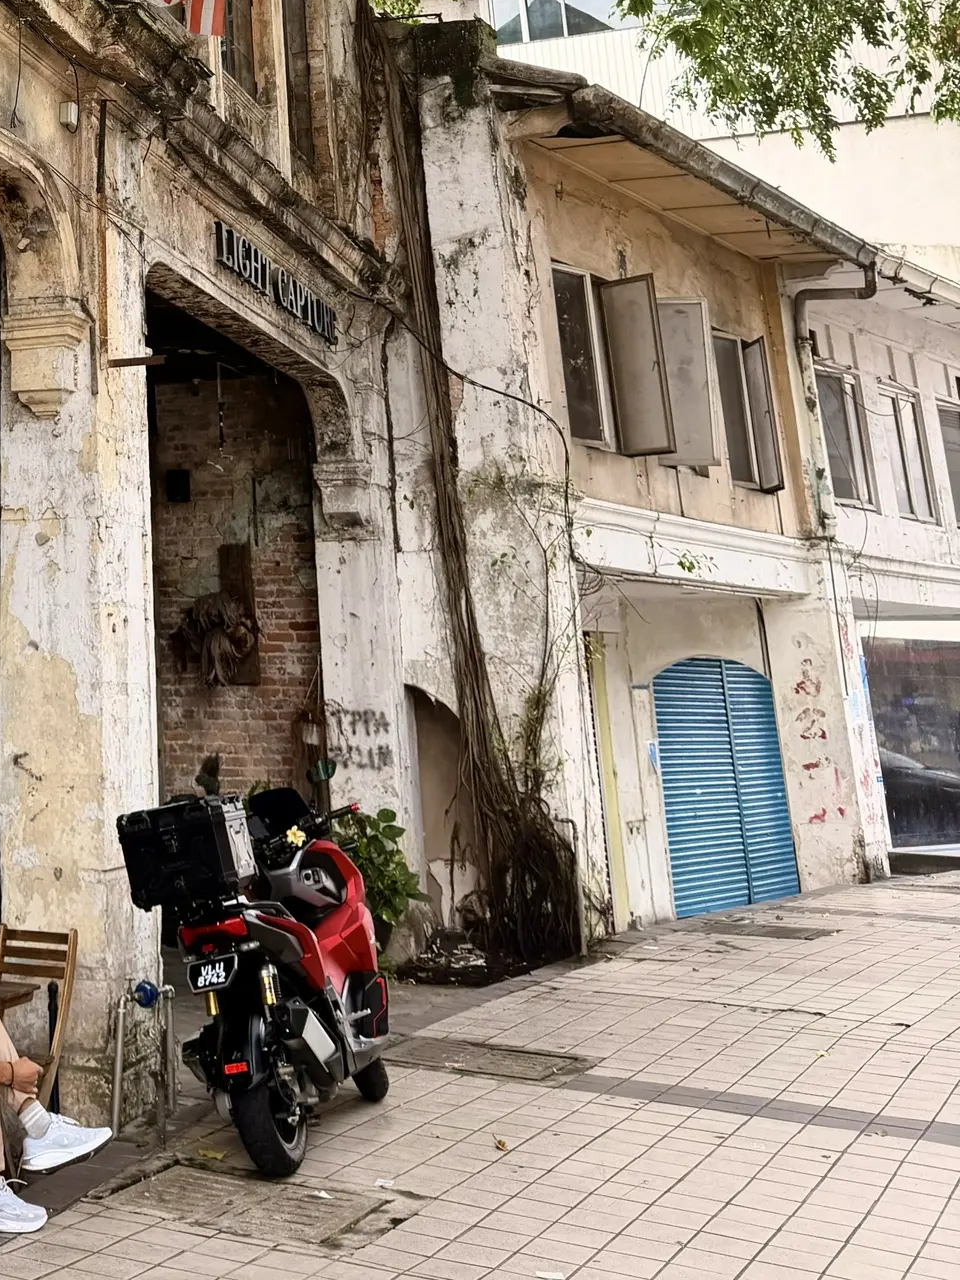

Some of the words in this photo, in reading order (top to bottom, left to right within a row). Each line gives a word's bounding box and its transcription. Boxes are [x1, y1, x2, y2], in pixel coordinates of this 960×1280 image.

[214, 220, 272, 297] LIGHT
[272, 266, 338, 346] CAPTURE
[201, 961, 224, 976] VLU
[197, 972, 226, 987] 8742
